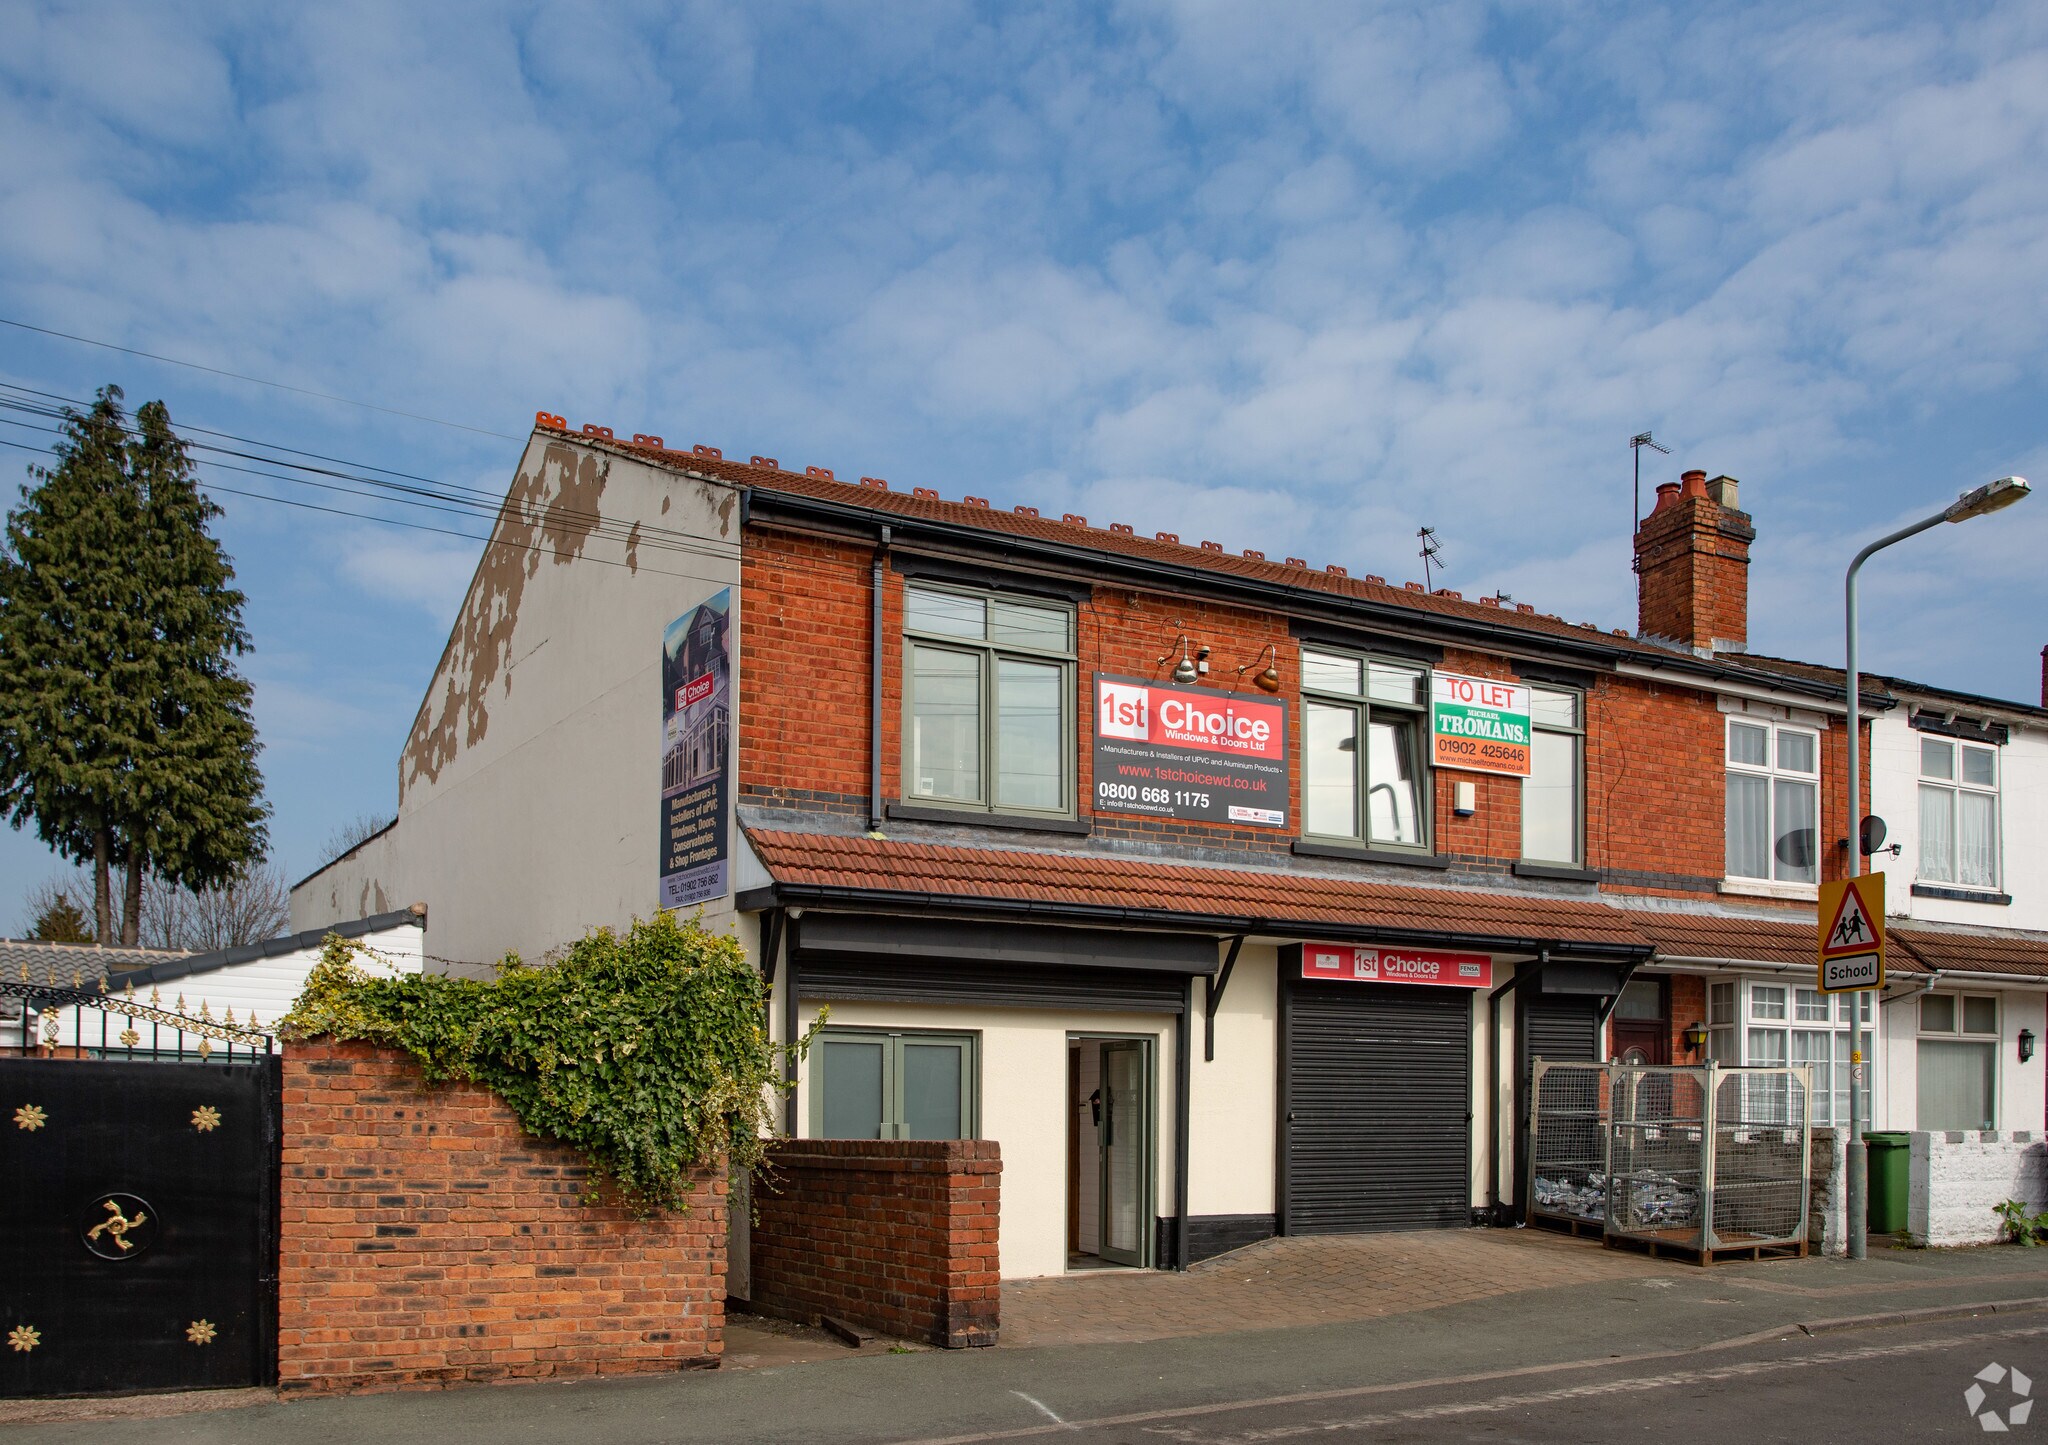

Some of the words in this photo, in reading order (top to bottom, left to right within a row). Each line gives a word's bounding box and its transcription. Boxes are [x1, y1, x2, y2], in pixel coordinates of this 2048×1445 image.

[687, 680, 710, 698] Choice
[1446, 678, 1474, 702] TO
[1480, 684, 1515, 709] LET
[1103, 693, 1145, 728] 1st
[1160, 699, 1270, 742] Choice
[1467, 709, 1500, 720] MICHAEL
[1165, 729, 1209, 744] Windows
[1211, 735, 1218, 745] &
[1220, 736, 1248, 749] Doors
[1250, 740, 1265, 751] Ltd
[1439, 714, 1524, 743] TROMANS
[1104, 744, 1148, 757] Manufacturers
[1150, 750, 1155, 758] &
[1156, 751, 1183, 762] Installers
[1192, 756, 1209, 765] UPVC
[1223, 760, 1253, 770] Aluminium
[1254, 763, 1279, 773] Products
[1439, 739, 1476, 755] 01902
[1481, 744, 1525, 762] 425646
[1440, 754, 1524, 771] www.michaeltromans.co.uk
[1118, 764, 1267, 792] www.1stchoicewd.co.uk
[671, 787, 711, 811] Manufacturers
[711, 783, 717, 795] &
[1098, 782, 1137, 800] 0800
[1141, 787, 1170, 804] 668
[1174, 790, 1210, 808] 1175
[1106, 799, 1174, 813] info@1stchoicewd.co.uk
[670, 808, 696, 826] Installers
[696, 803, 702, 816] of
[703, 798, 718, 814] uPVC
[671, 823, 697, 840] Windows,
[698, 817, 717, 831] Doors,
[673, 832, 714, 853] Conservatories
[669, 857, 674, 869] &
[675, 854, 689, 867] Shop
[689, 846, 718, 863] Frontages
[680, 879, 697, 892] 01902
[1356, 954, 1377, 972] 1st
[1383, 954, 1440, 974] Choice
[1829, 961, 1873, 980] School
